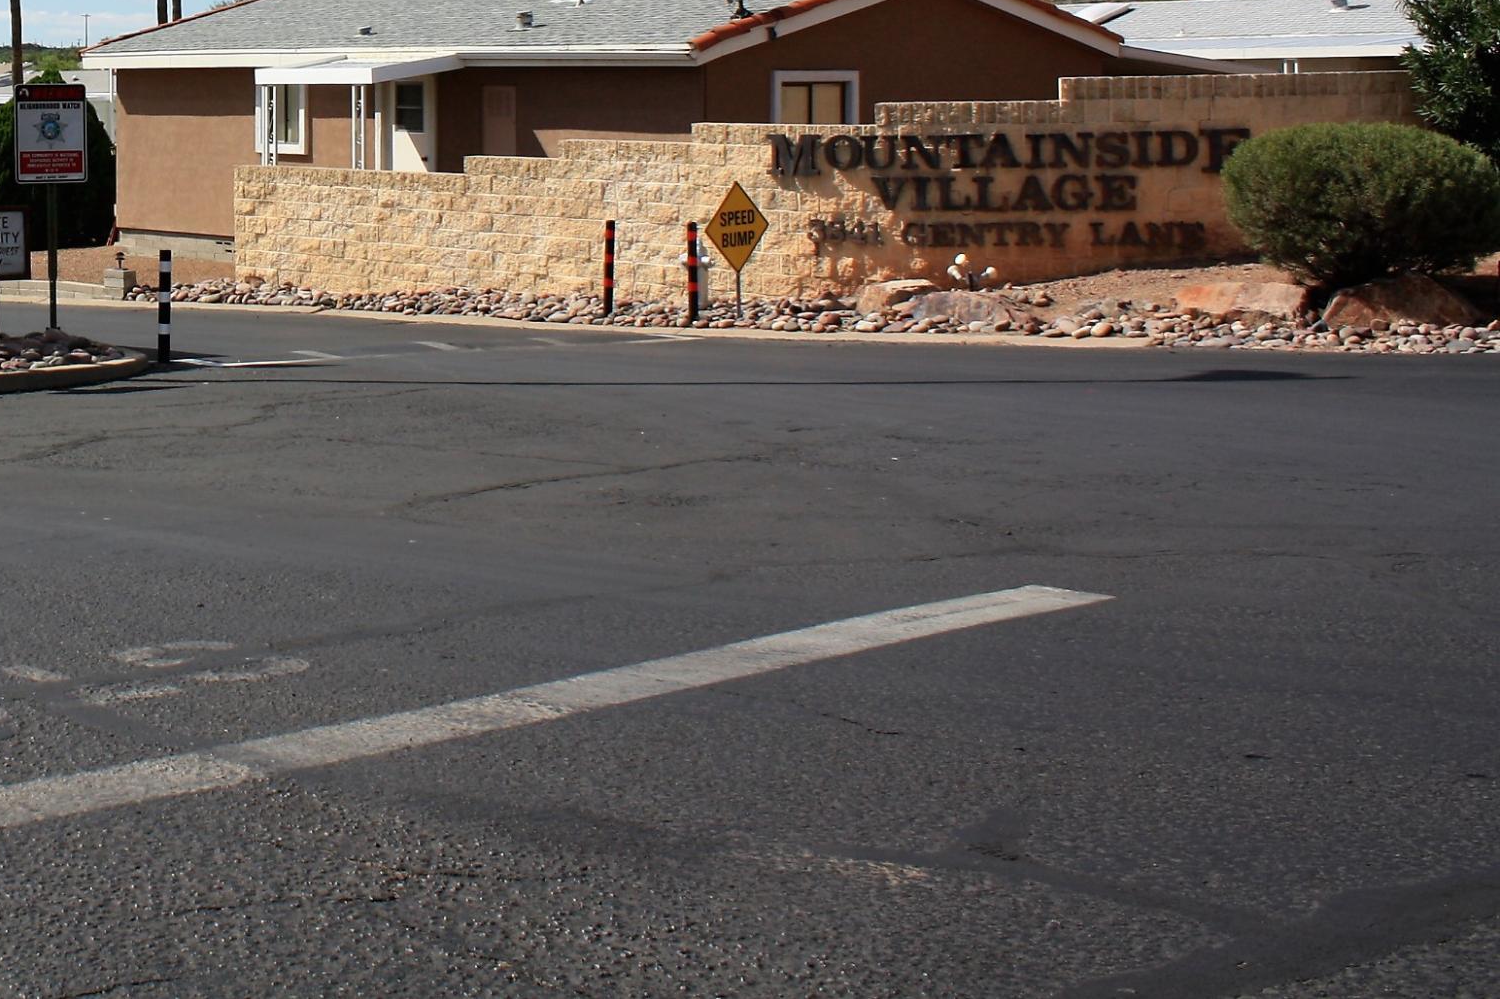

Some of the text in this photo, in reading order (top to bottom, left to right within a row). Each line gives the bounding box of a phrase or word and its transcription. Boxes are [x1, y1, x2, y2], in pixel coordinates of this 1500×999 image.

[871, 174, 1138, 213] VILLAGE
[720, 209, 755, 227] SPEED
[722, 230, 755, 248] BUMP
[901, 221, 1070, 249] GENTRY
[1089, 221, 1206, 250] LANE
